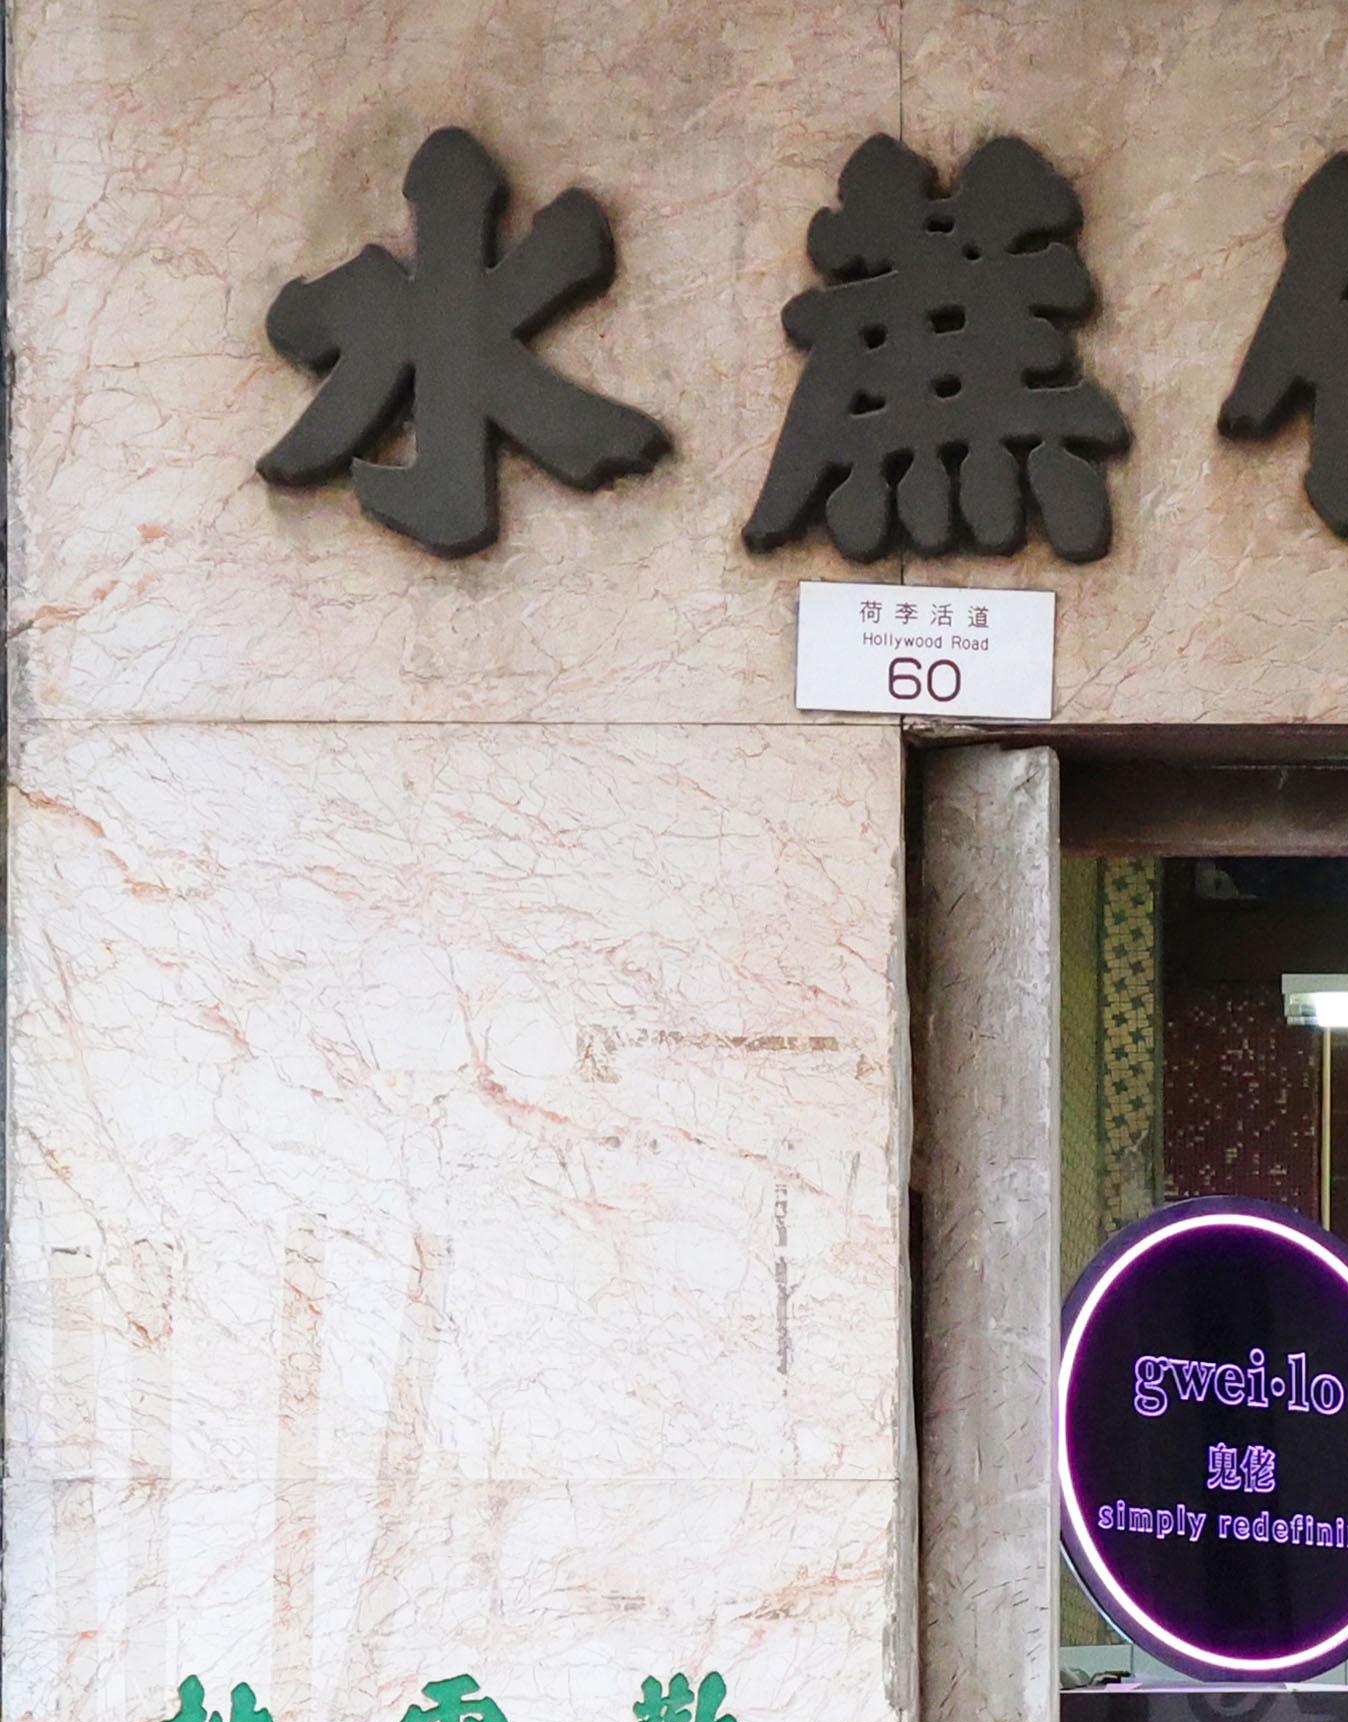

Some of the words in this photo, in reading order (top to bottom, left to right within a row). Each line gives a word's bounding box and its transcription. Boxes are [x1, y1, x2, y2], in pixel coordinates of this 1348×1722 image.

[859, 600, 990, 628] 荷李活道
[862, 632, 942, 650] Hollywood
[951, 635, 989, 651] Road
[888, 657, 961, 702] 60
[1207, 1442, 1277, 1493] 鬼佬
[1098, 1499, 1207, 1542] simply
